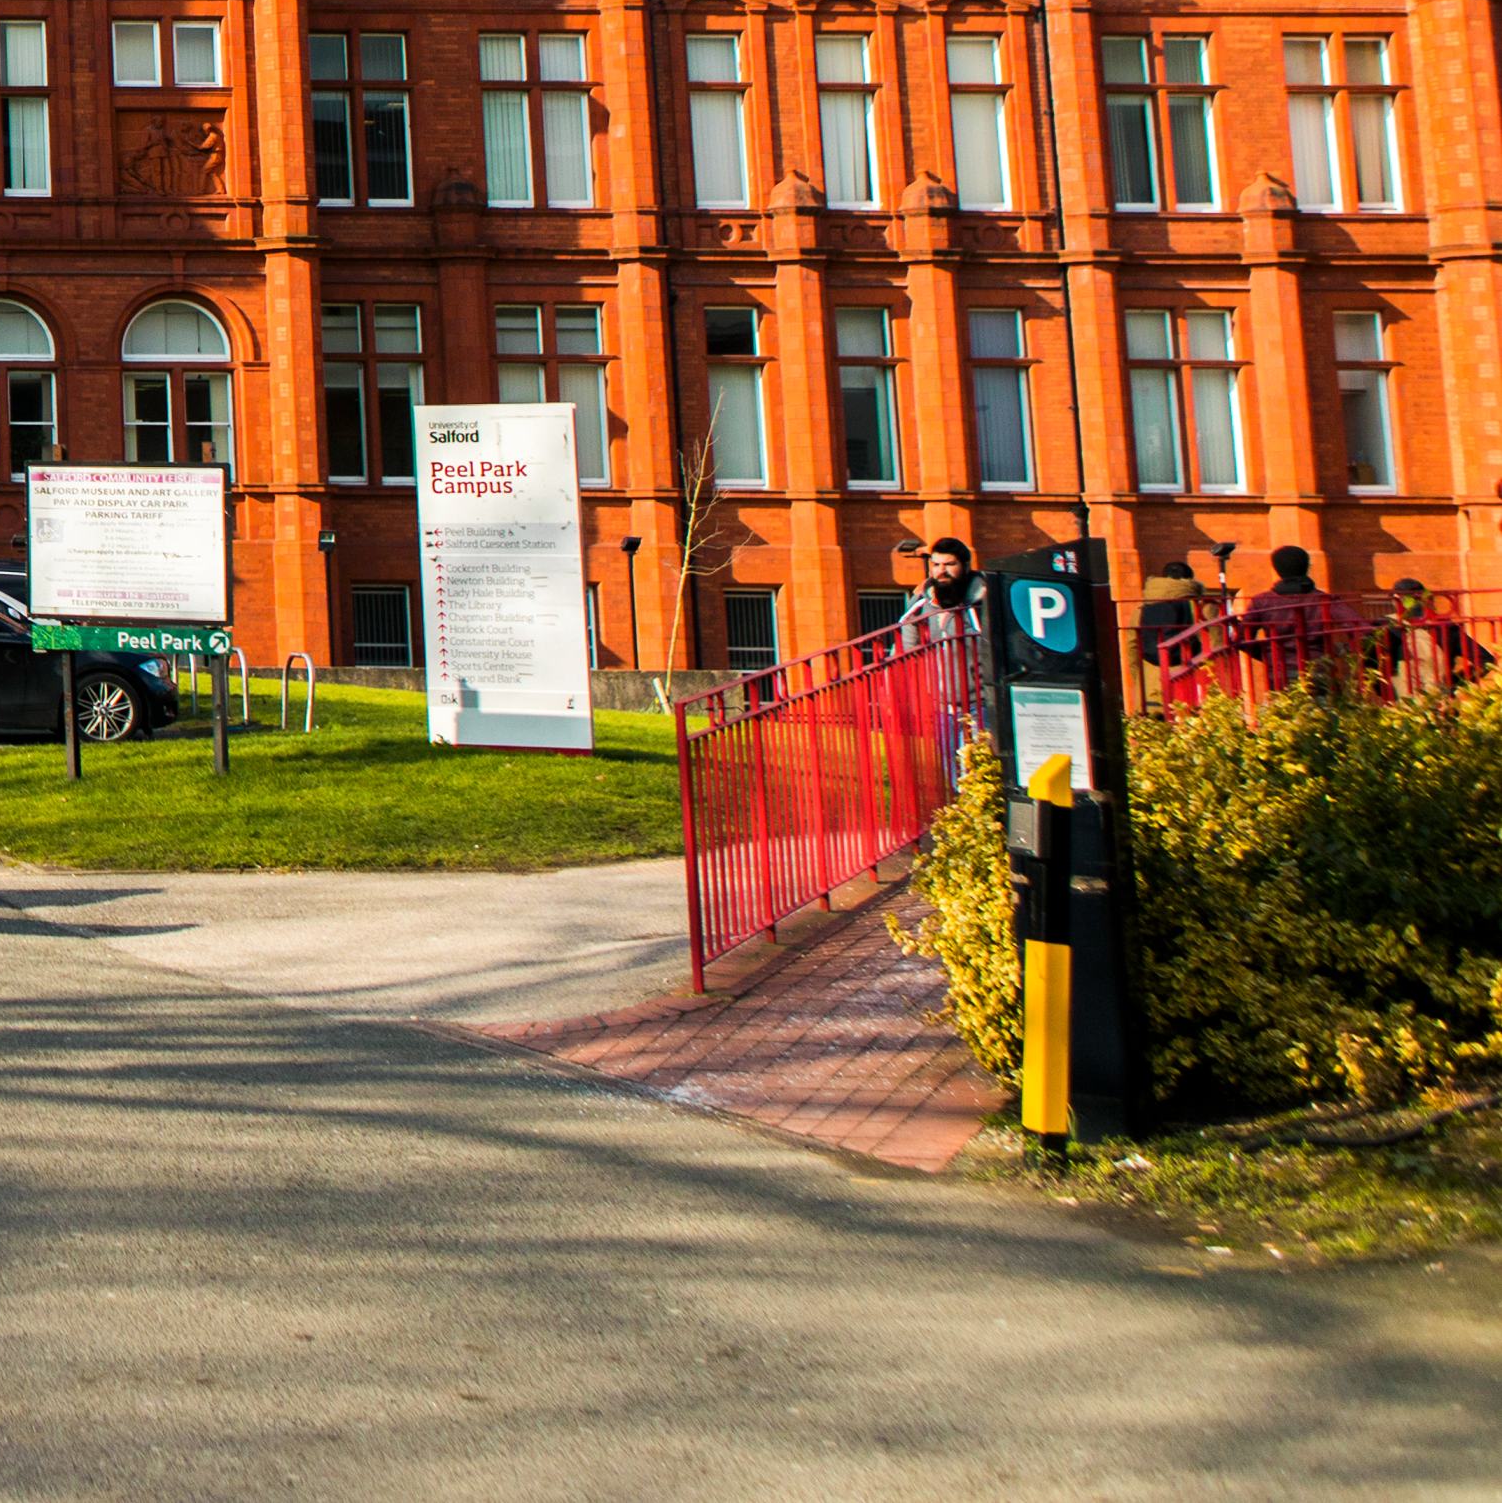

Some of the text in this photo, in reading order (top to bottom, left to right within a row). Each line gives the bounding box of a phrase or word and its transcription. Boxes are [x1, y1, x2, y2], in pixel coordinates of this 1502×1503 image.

[429, 421, 478, 430] University of
[429, 429, 480, 444] Salford
[431, 460, 528, 478] Peel Park
[43, 472, 91, 482] SALFORD
[93, 473, 161, 483] COMMUNITY
[34, 486, 219, 497] SALFORD MUSEUM AND ART GALLERY
[432, 478, 513, 498] Campus
[53, 498, 189, 509] PAY AND DISPLAY CAR PARK
[85, 511, 164, 520] PARKING TARIFF
[444, 527, 506, 538] Peel Building
[445, 539, 556, 549] Salford Crescent Station
[445, 564, 531, 575] Cockcroft Building
[446, 576, 525, 587] Newton Building
[447, 588, 535, 600] Lady Hale Building
[71, 599, 119, 607] TELEPHONE:
[448, 600, 502, 611] The Library
[448, 612, 534, 624] Chapman Building
[1028, 586, 1067, 639] P
[449, 624, 513, 635] Horlock Court
[117, 631, 203, 651] Peel Park
[449, 636, 535, 647] Constantine Court
[451, 648, 533, 660] University House
[451, 660, 515, 672] Sports Centre
[477, 673, 495, 683] and
[497, 673, 522, 684] Bank
